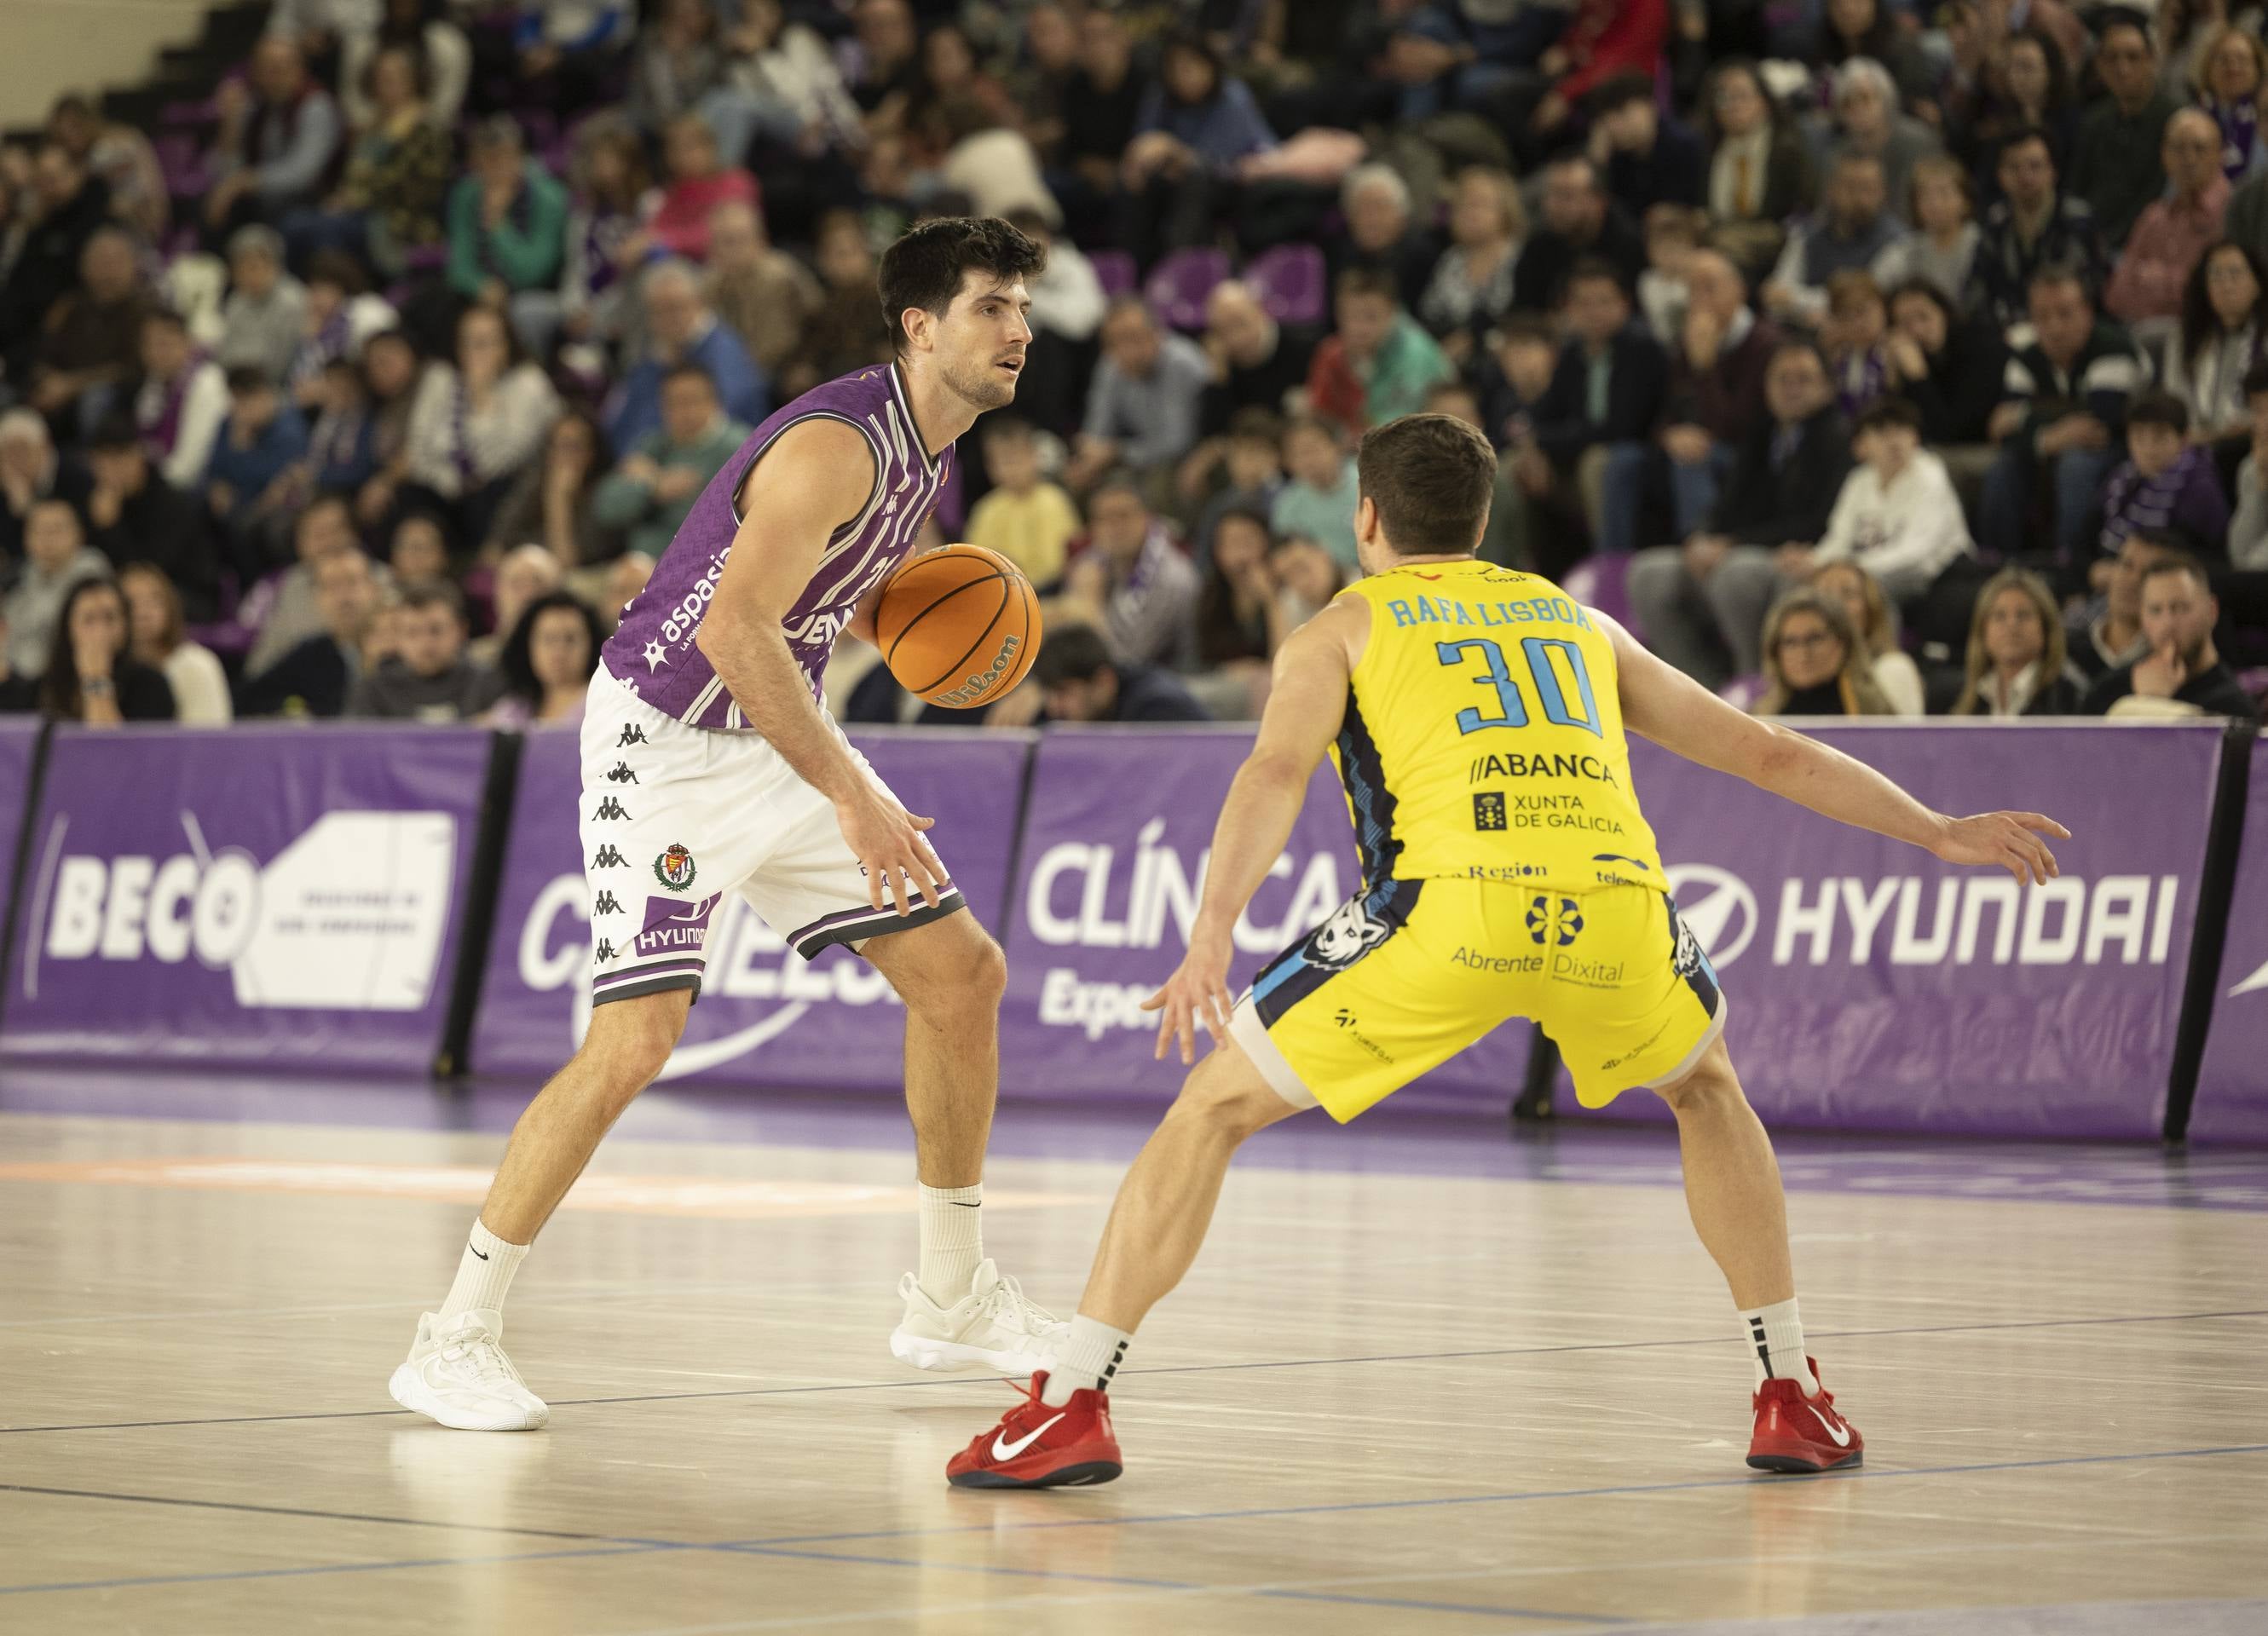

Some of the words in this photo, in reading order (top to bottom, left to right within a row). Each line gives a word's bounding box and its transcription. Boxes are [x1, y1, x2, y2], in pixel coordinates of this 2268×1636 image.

[1388, 595, 1476, 627] RAFA
[1476, 597, 1592, 632] LISBOA
[934, 634, 1021, 706] Wilson
[1435, 637, 1602, 739] 30
[1515, 795, 1584, 810] XUNTA
[1515, 814, 1542, 828] DE
[1547, 814, 1625, 835] GALICIA
[48, 854, 258, 965] BECO
[1026, 818, 1340, 954] CLÍNCA
[1773, 876, 2179, 965] HYUNDAI
[1451, 947, 1543, 973] Abrente
[1553, 953, 1624, 982] Dixital
